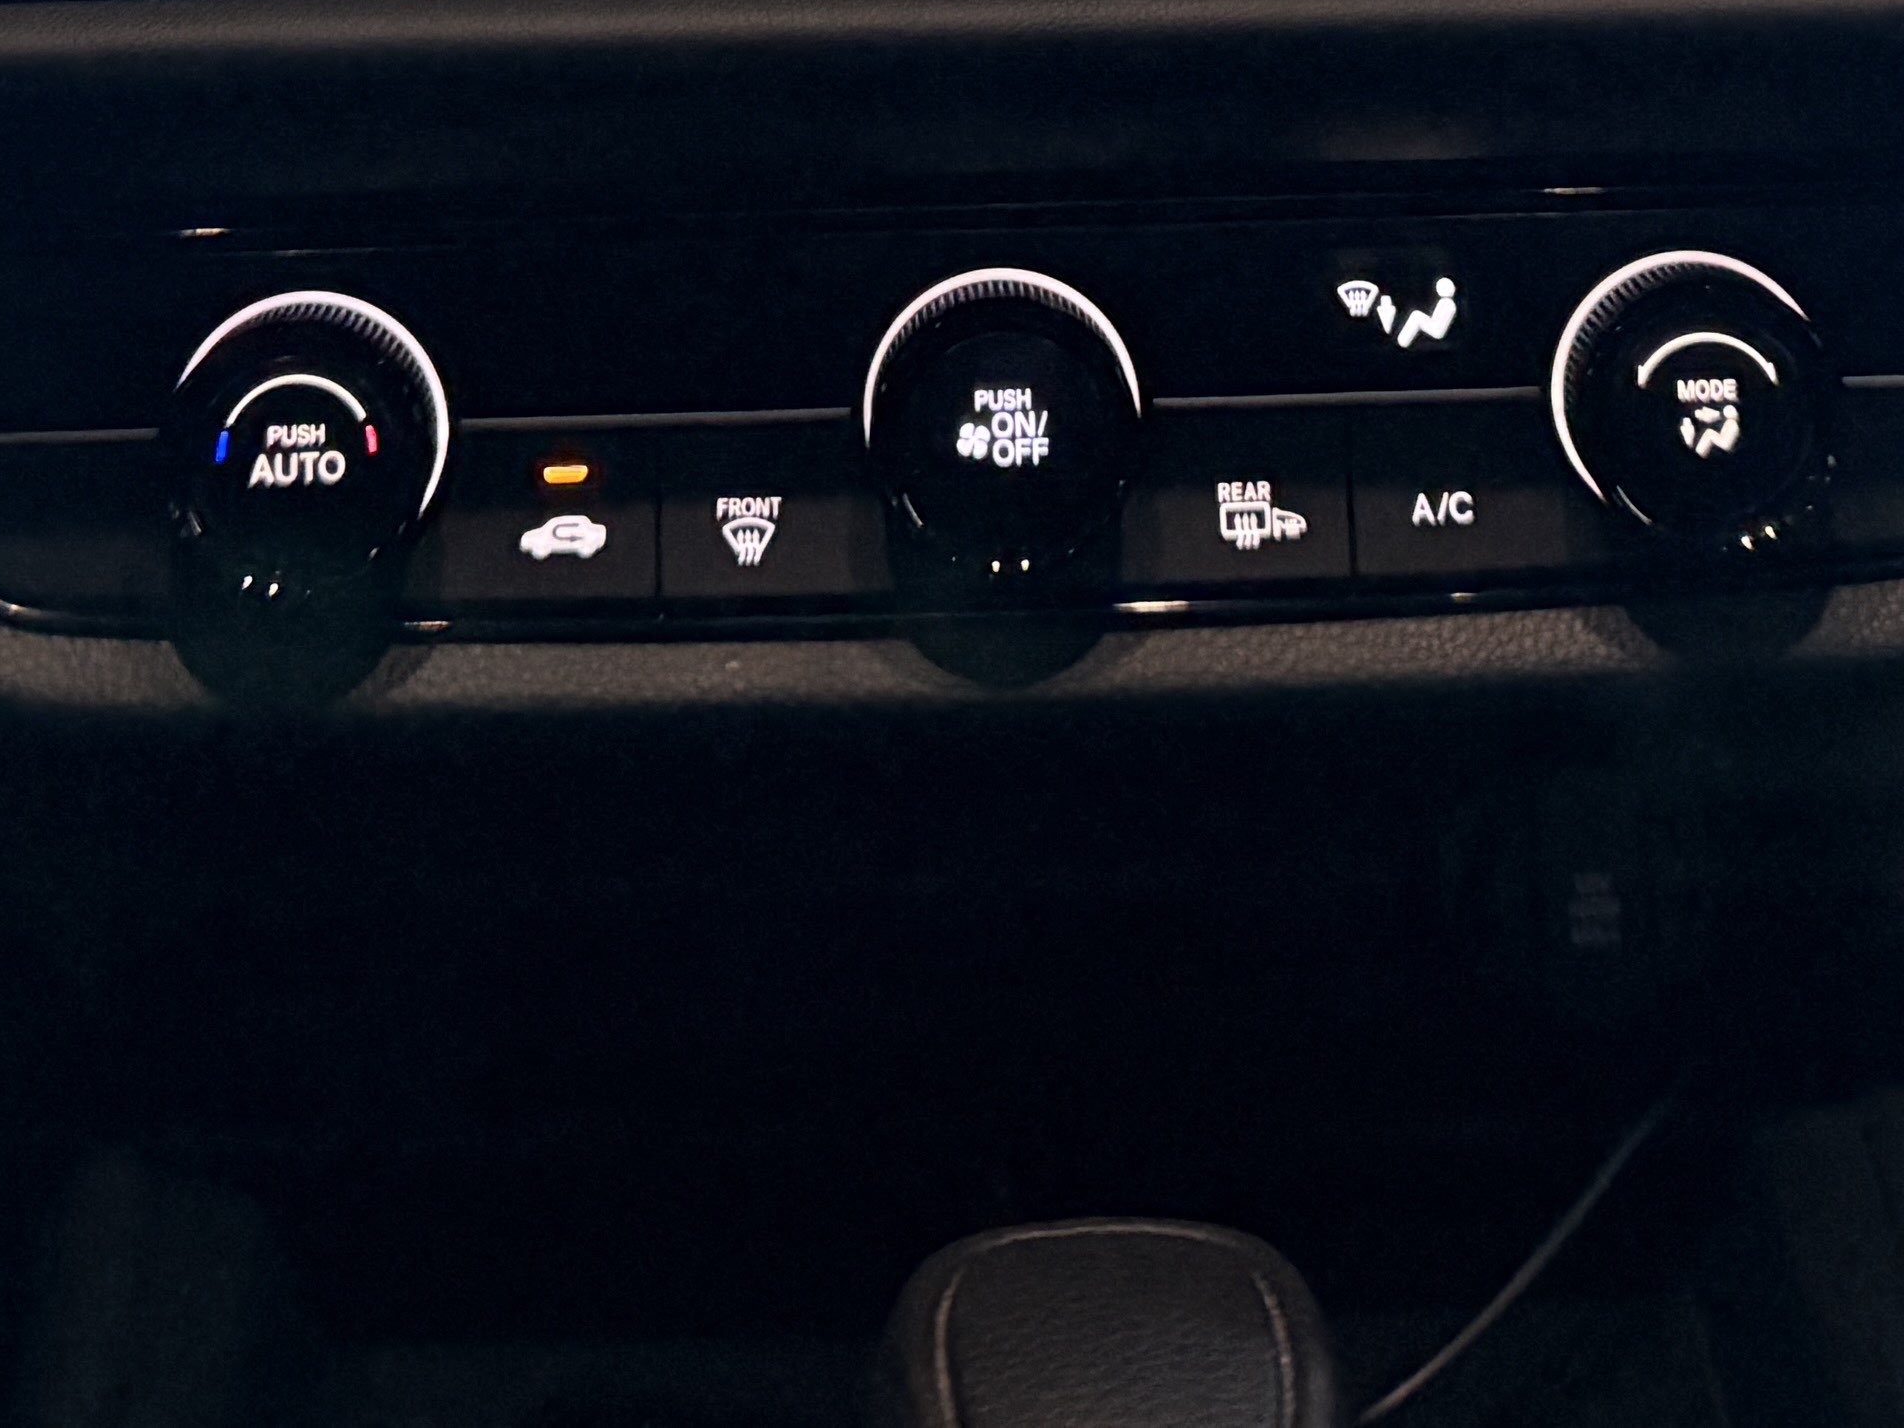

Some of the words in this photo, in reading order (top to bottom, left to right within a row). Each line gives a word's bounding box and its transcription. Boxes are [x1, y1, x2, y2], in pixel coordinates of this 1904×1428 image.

[973, 387, 1033, 412] PUSH
[1676, 378, 1739, 407] MODE
[266, 423, 326, 448] PUSH
[990, 438, 1051, 468] OFF
[249, 450, 346, 487] AUTO
[1217, 480, 1272, 505] REAR
[716, 496, 782, 521] FRONT
[1411, 490, 1474, 525] A/C
